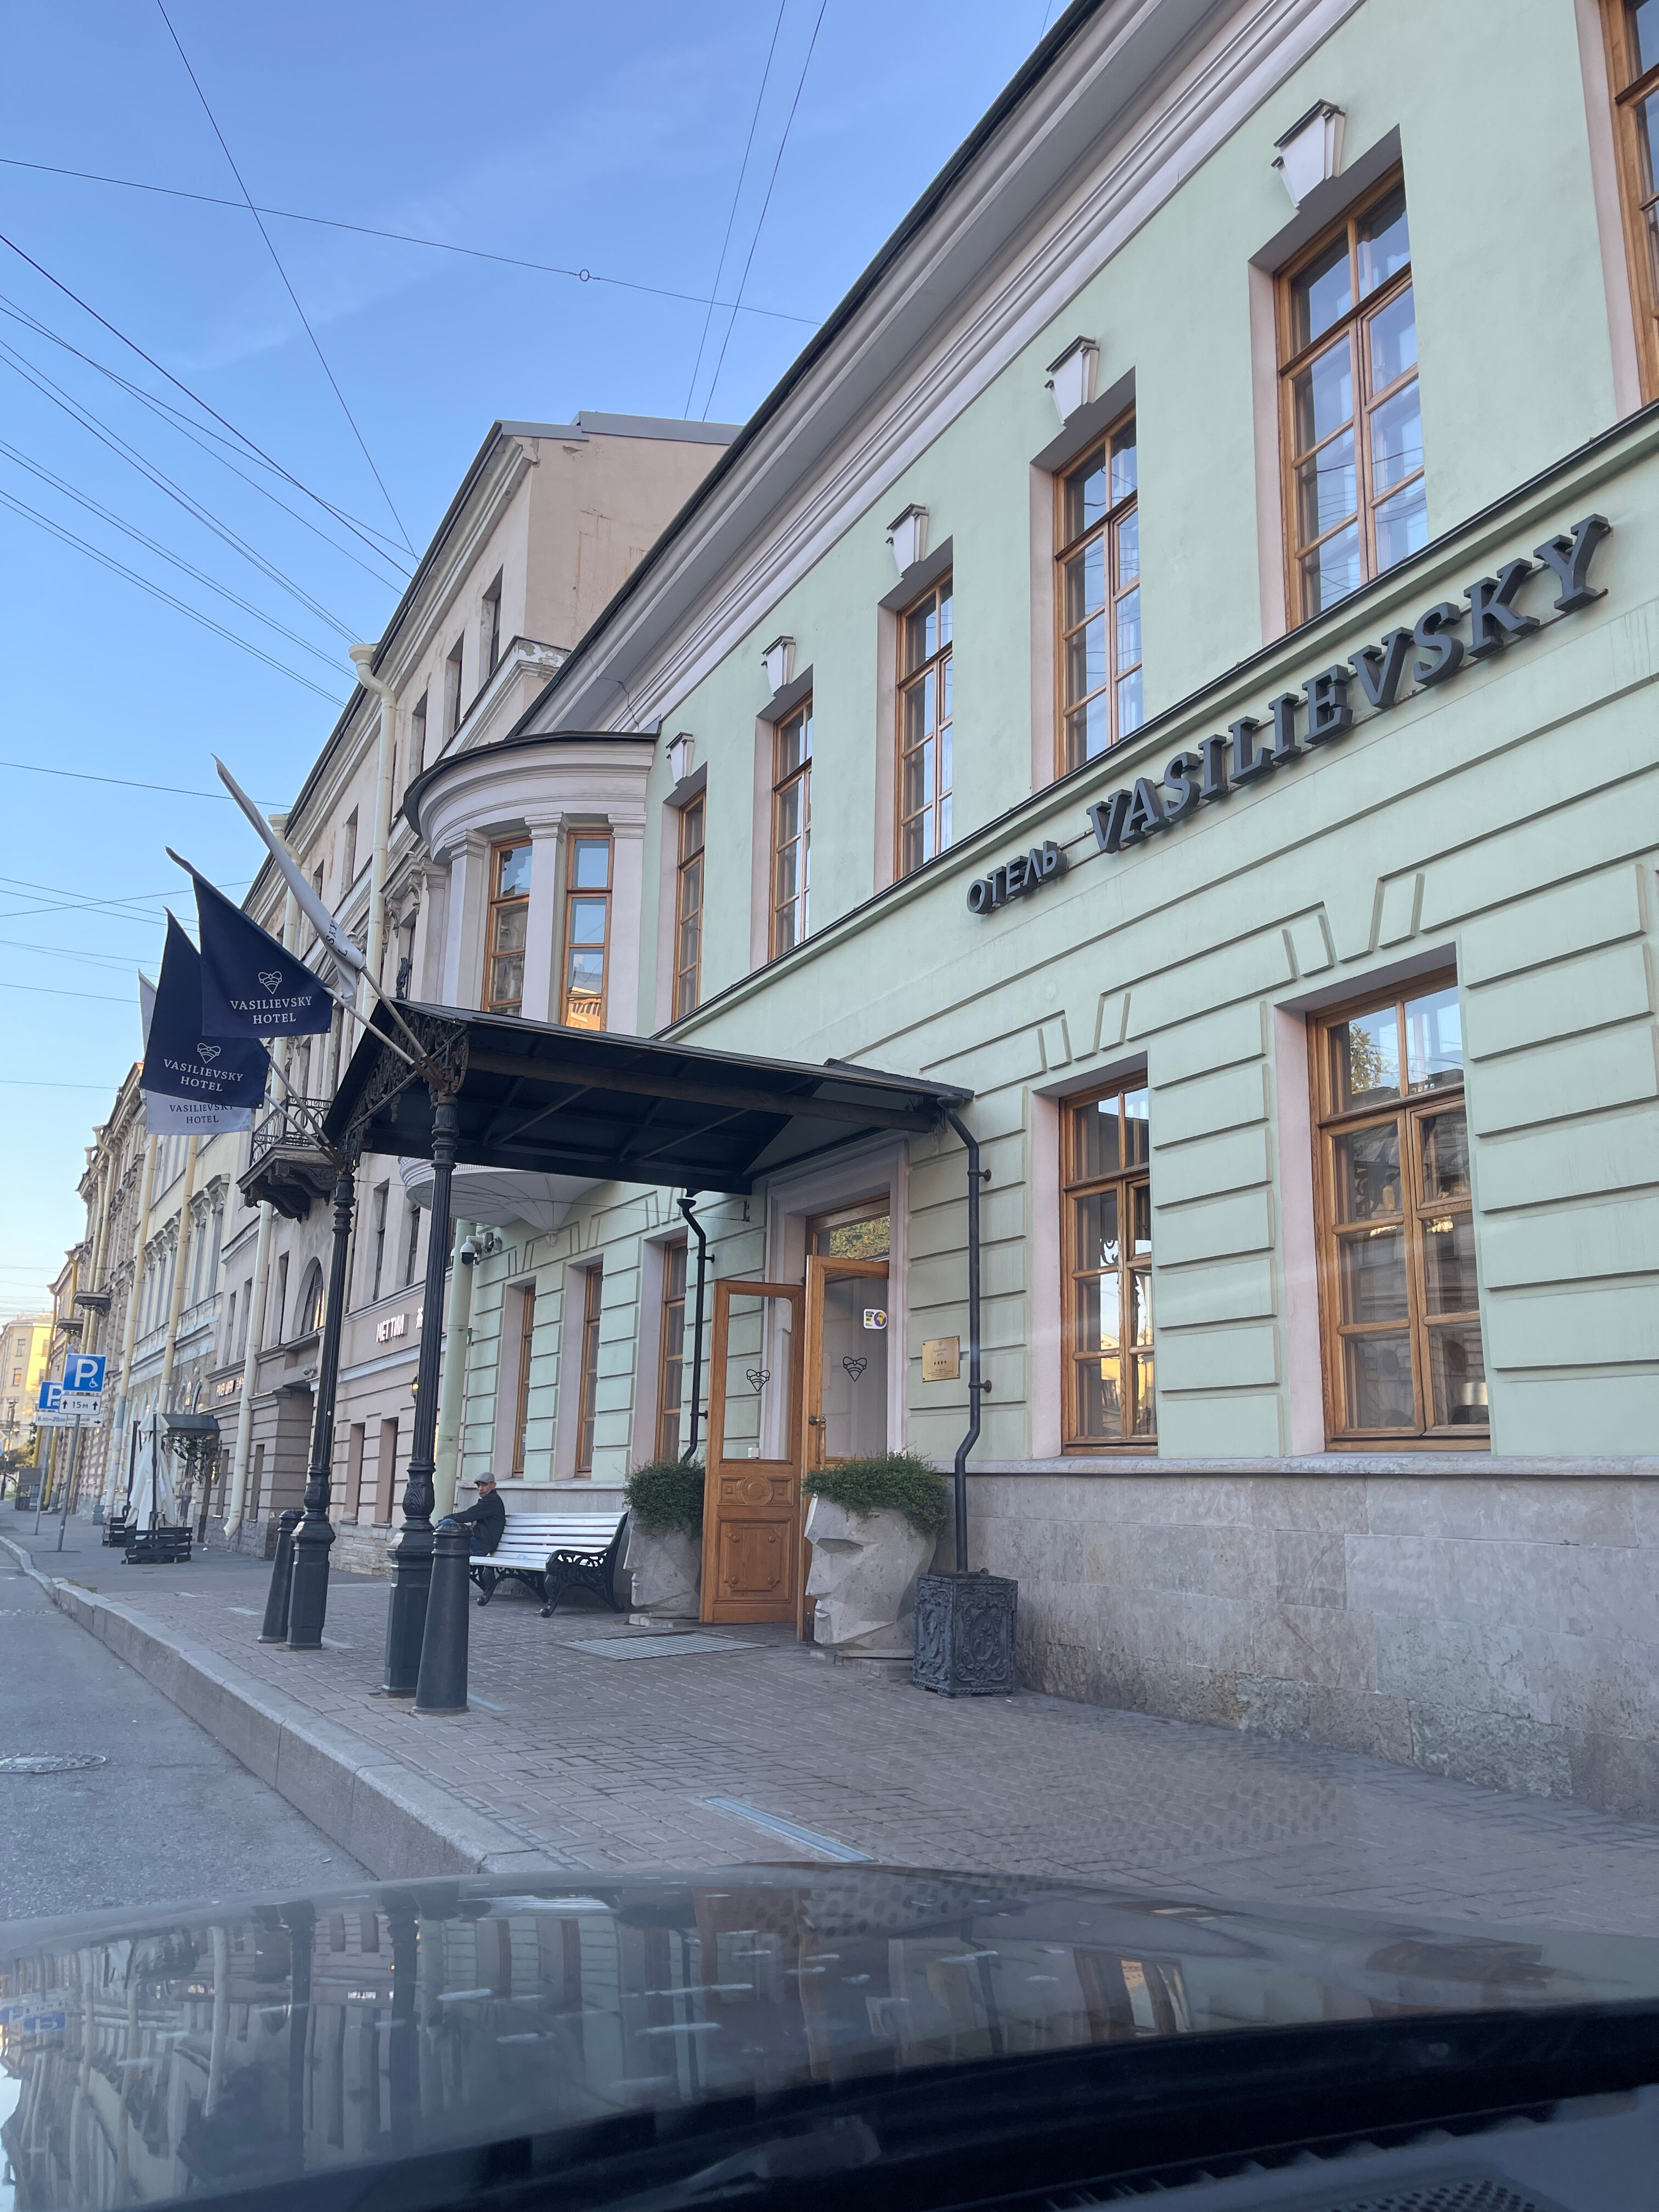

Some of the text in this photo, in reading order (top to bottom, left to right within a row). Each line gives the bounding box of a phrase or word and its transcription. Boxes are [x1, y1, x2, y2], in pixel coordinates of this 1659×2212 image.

[967, 513, 1612, 915] ОТЕЛЬ VASILIEVSKY
[230, 996, 312, 1010] VASILIEVSKY
[252, 1013, 296, 1024] HOTEL
[163, 1058, 244, 1082] VASILIEVSKY
[180, 1076, 223, 1092] HOTEL
[186, 1115, 219, 1124] HOTEL
[74, 1358, 98, 1387] P
[47, 1385, 65, 1407] P
